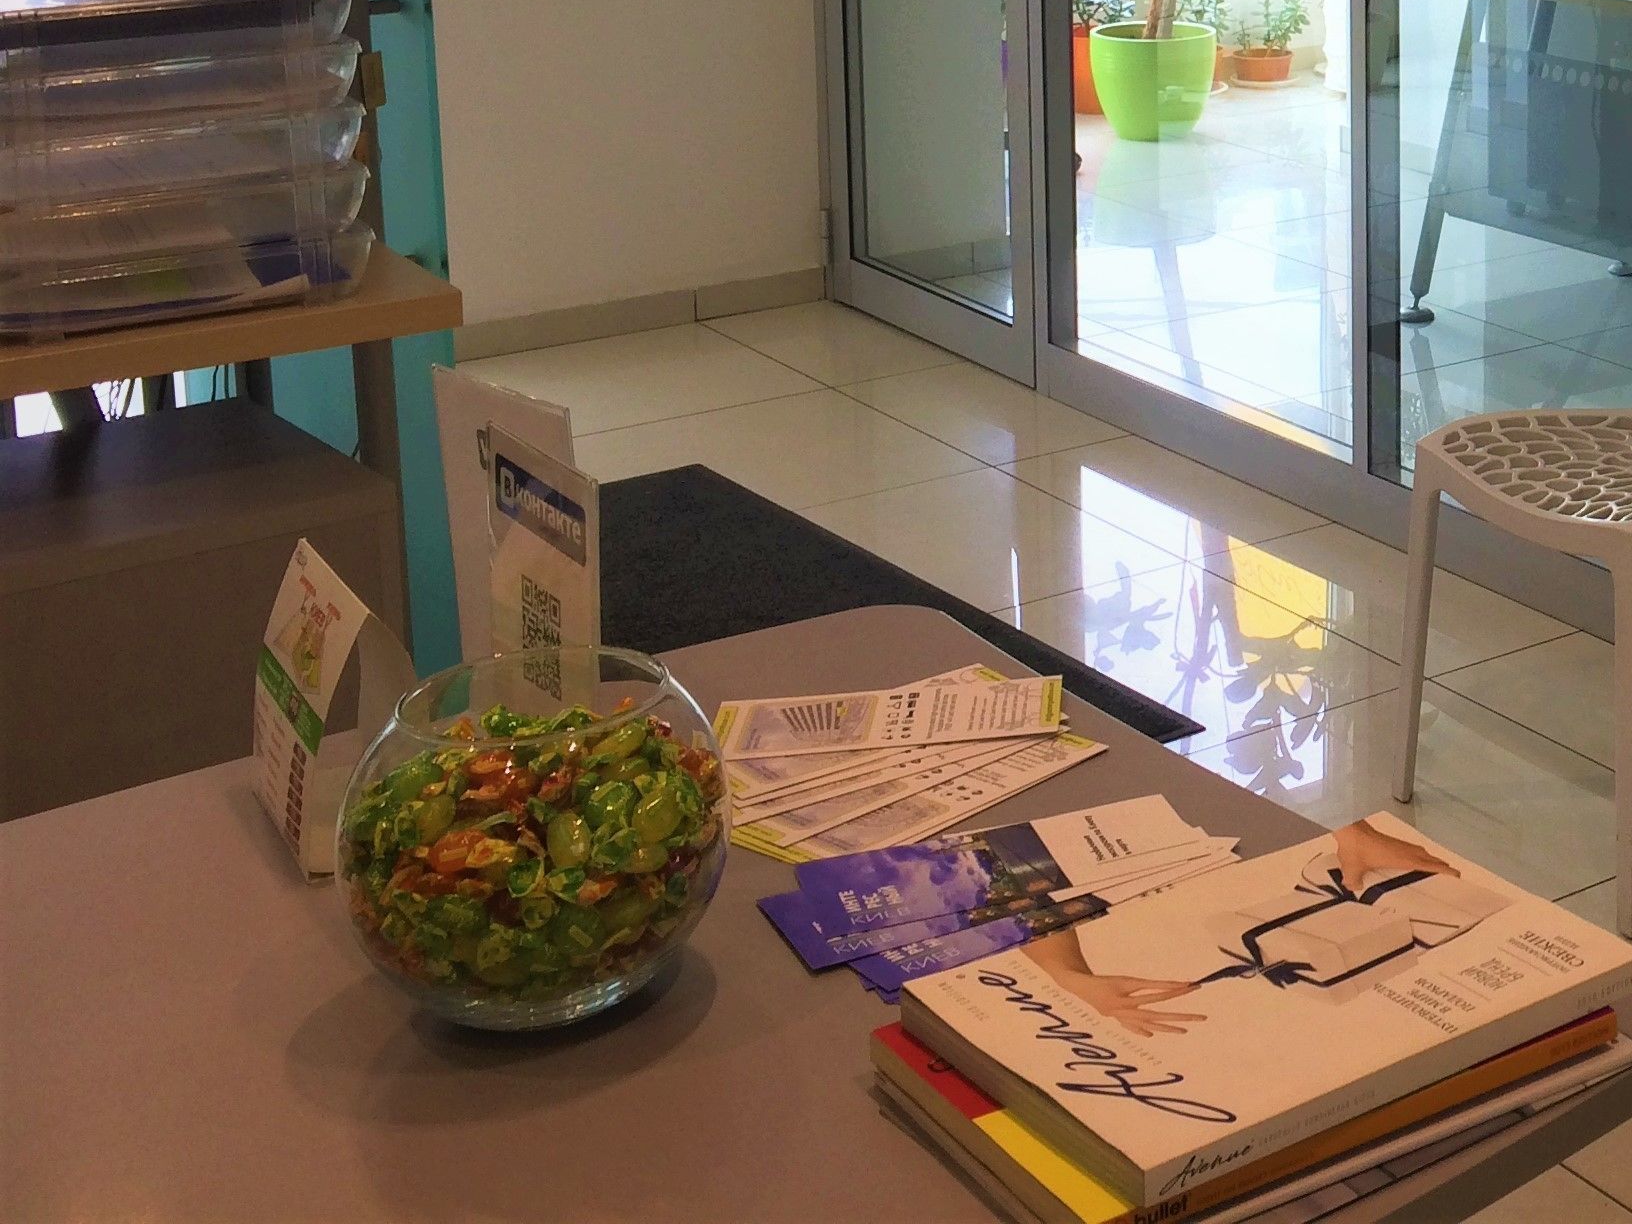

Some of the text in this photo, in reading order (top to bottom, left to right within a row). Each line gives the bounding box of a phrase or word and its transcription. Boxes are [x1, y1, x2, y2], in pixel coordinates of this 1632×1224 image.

[899, 946, 962, 974] КИЕВ
[1518, 929, 1586, 969] СВЕЖИЕ
[1458, 964, 1509, 991] НОВЫЙ
[1479, 956, 1526, 984] БРЕНД
[1371, 981, 1460, 1036] ПУТЕВОДИТЕЛЬ
[1406, 987, 1450, 1015] В МИРЕ
[1413, 976, 1477, 1014] ПОДАРКОВ
[978, 969, 1238, 1124] Avenue
[1159, 1137, 1256, 1197] Avenue
[1134, 1193, 1189, 1224] bullet
